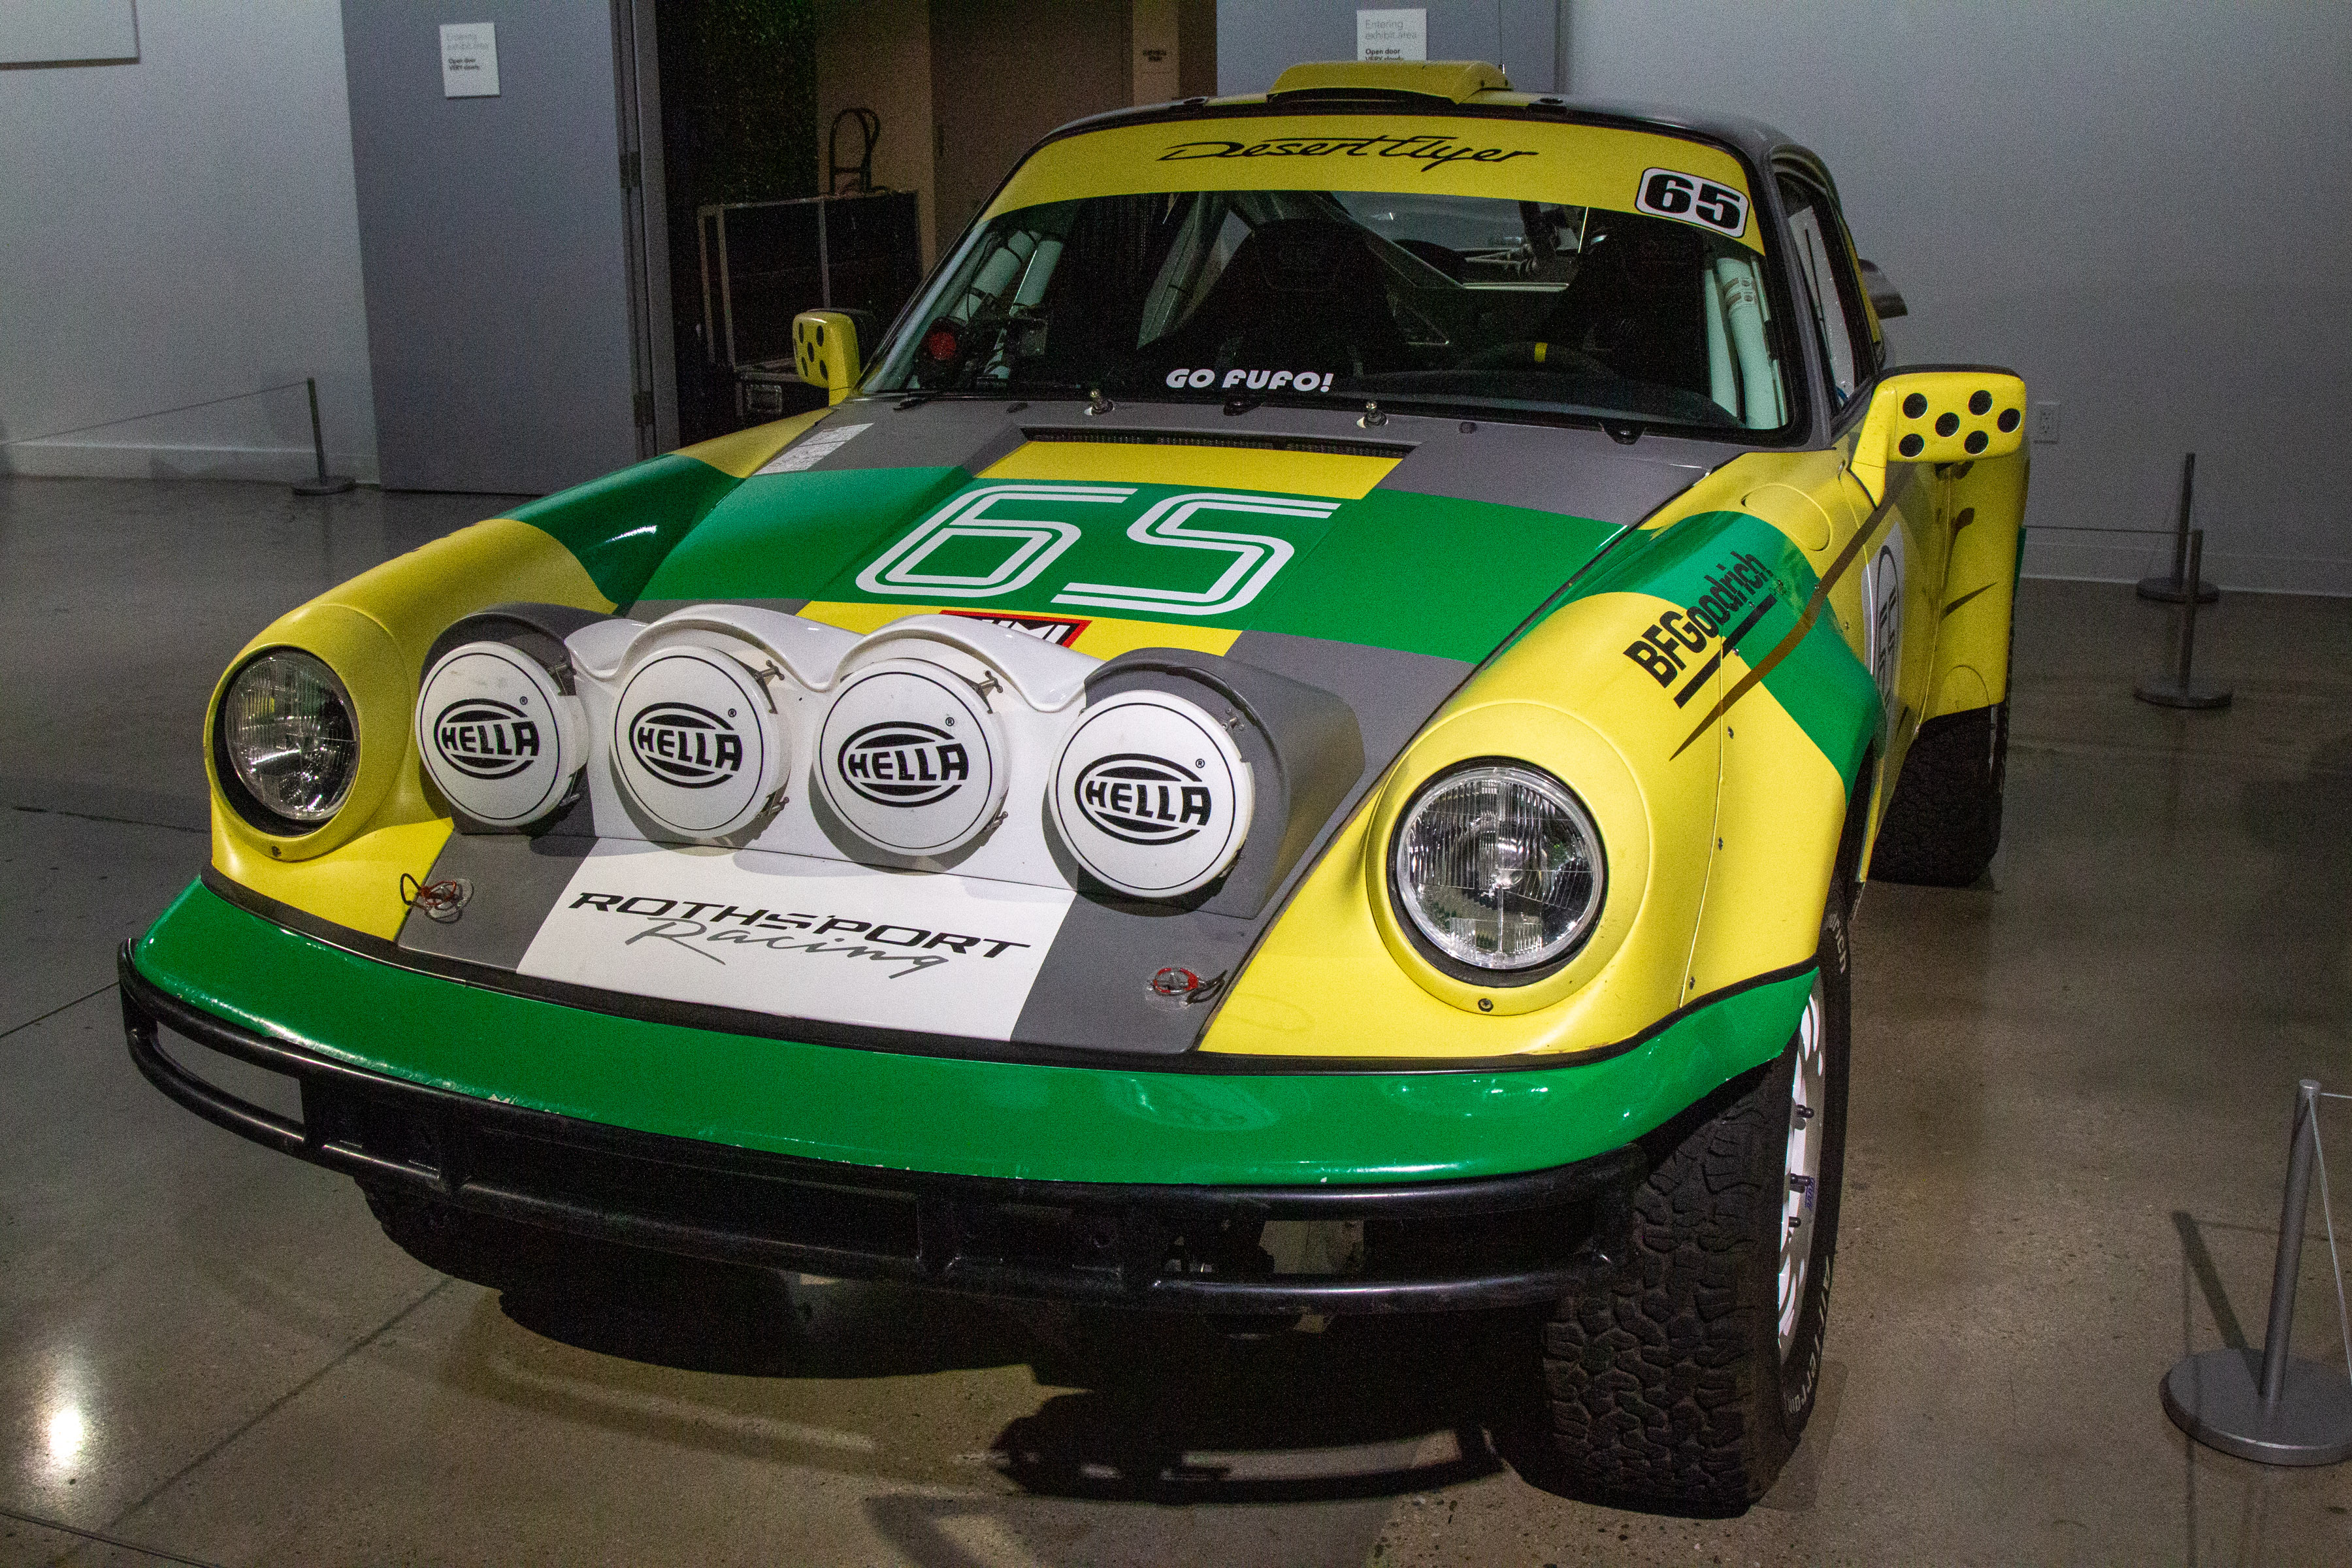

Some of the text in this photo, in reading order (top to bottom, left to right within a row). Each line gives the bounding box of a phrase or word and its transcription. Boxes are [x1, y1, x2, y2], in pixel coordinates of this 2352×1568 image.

[1154, 135, 1390, 161] Desert
[1644, 173, 1741, 230] 65
[1166, 368, 1335, 392] GO FUFO!
[855, 484, 1342, 616] 65
[1622, 550, 1774, 689] BFGoodrich
[441, 721, 540, 757] HELLA
[637, 726, 743, 773] HELLA
[847, 743, 970, 782] HELLA
[1085, 780, 1213, 826] HELLA
[568, 892, 1032, 958] ROTHSPORT
[625, 917, 949, 979] Racing
